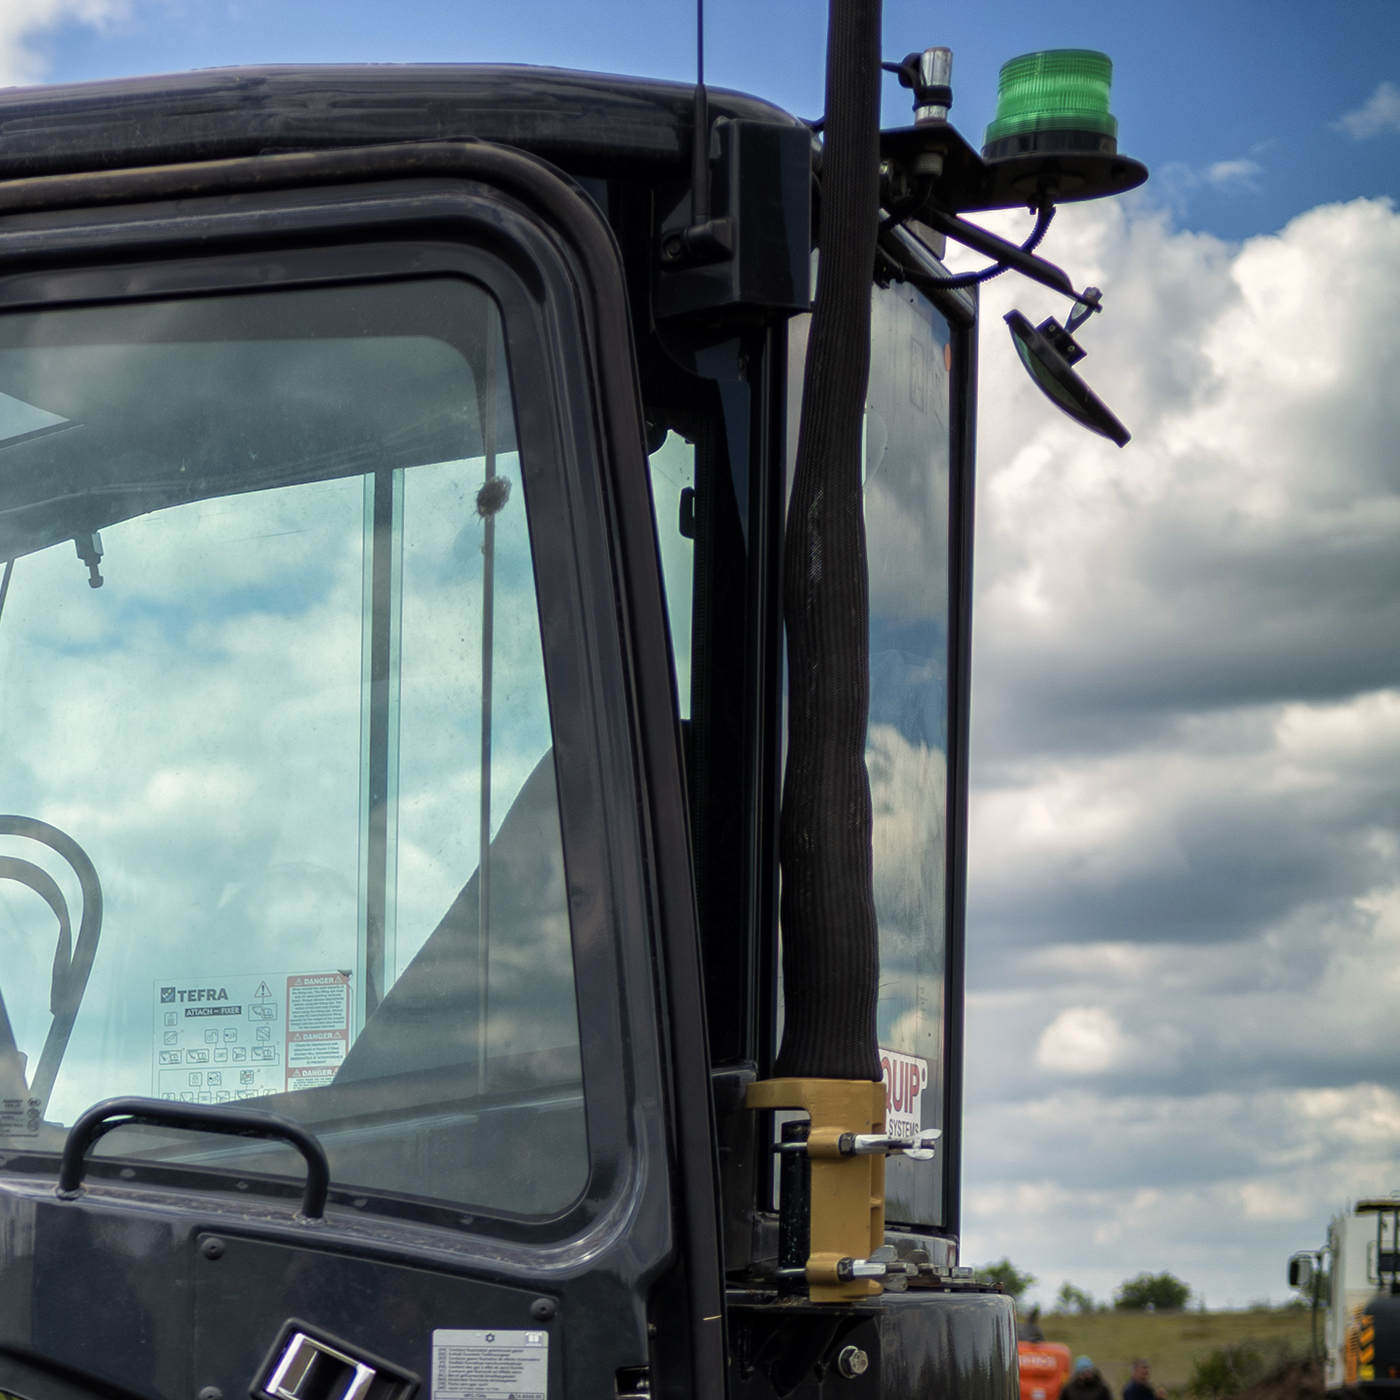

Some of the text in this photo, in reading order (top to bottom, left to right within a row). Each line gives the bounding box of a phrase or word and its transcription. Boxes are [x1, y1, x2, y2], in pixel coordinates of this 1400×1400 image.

[177, 988, 229, 1002] TEFRA
[186, 1008, 213, 1017] ATTACH
[221, 1006, 240, 1015] FIXER
[302, 1069, 333, 1077] DANGER
[881, 1056, 920, 1114] QUIP
